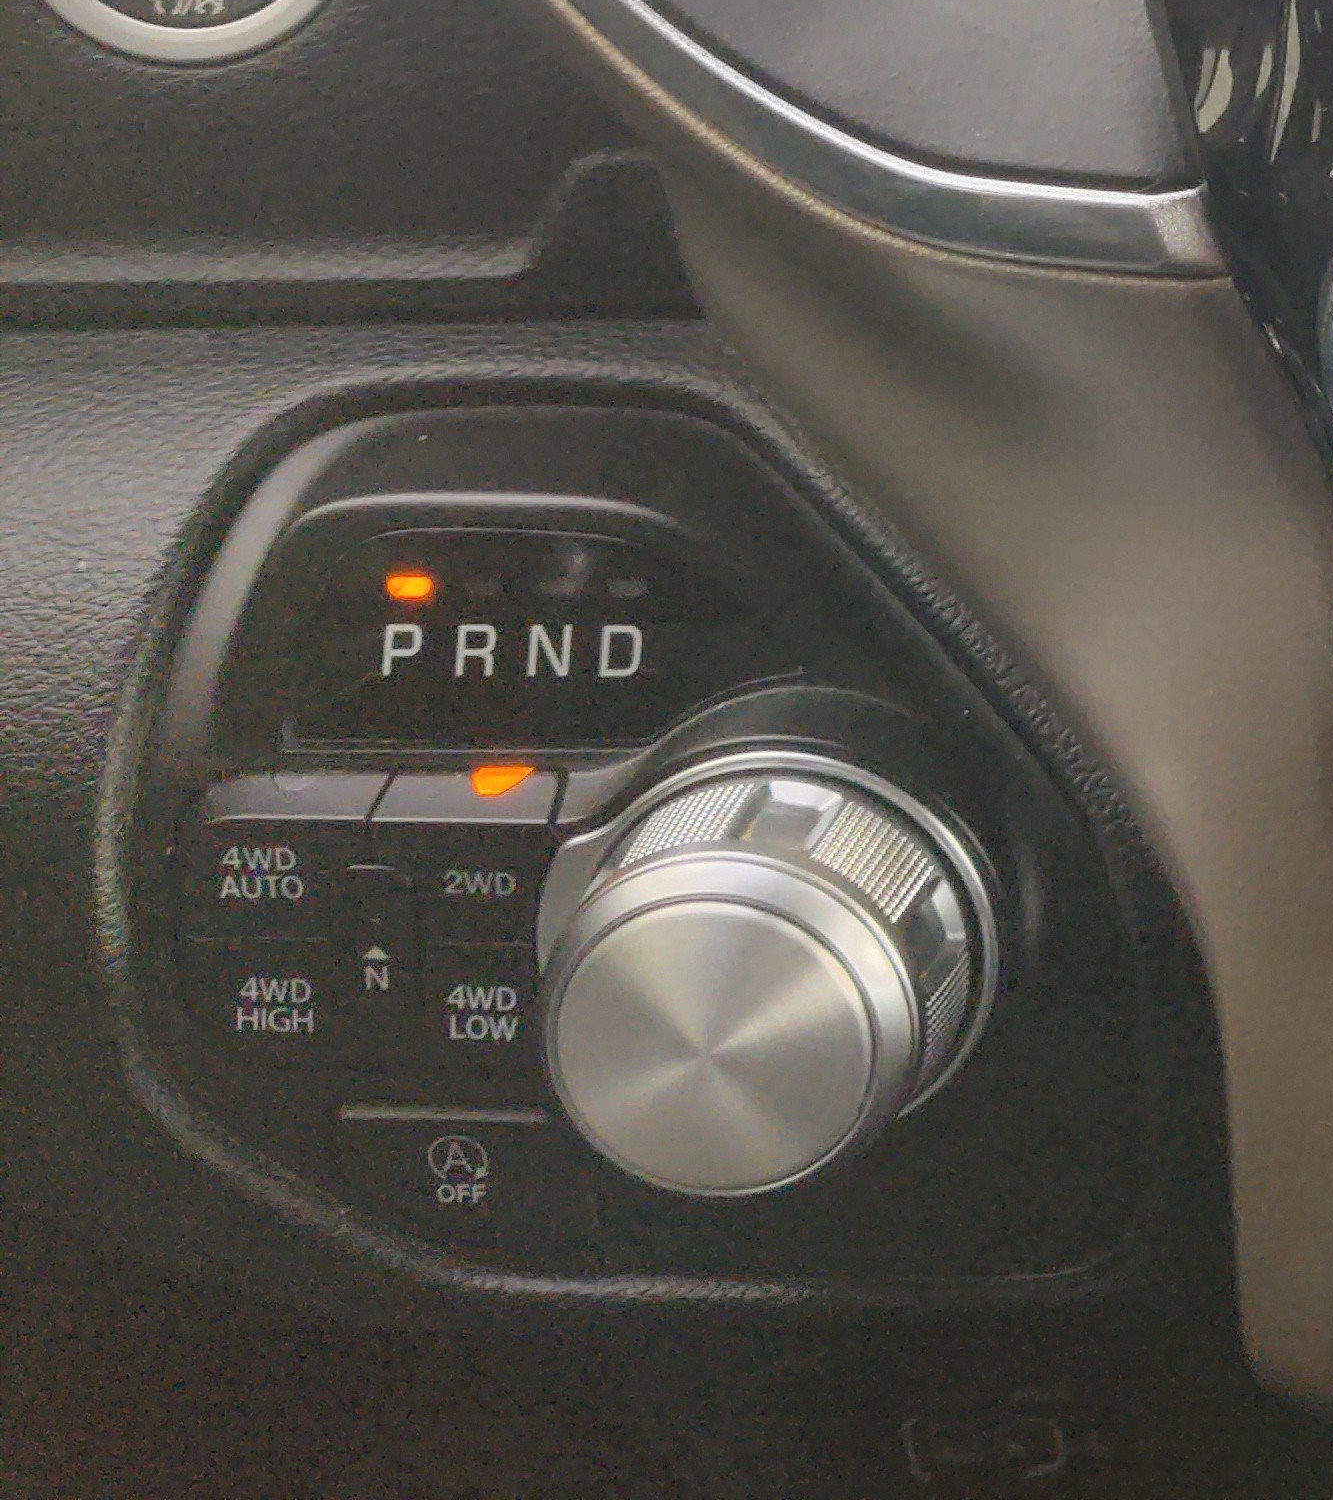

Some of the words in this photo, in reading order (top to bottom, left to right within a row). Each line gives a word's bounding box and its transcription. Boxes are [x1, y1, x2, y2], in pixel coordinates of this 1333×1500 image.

[382, 624, 423, 677] P
[454, 624, 497, 677] R
[526, 624, 573, 677] N
[599, 624, 643, 677] D
[222, 846, 298, 872] 4WD
[219, 875, 304, 901] AUTO
[442, 871, 516, 896] 2WD
[239, 978, 311, 1004] 4WD
[364, 966, 390, 991] N
[445, 985, 517, 1013] 4WD
[235, 1007, 315, 1034] HIGH
[448, 1015, 519, 1043] LOW
[436, 1184, 487, 1203] OFF
